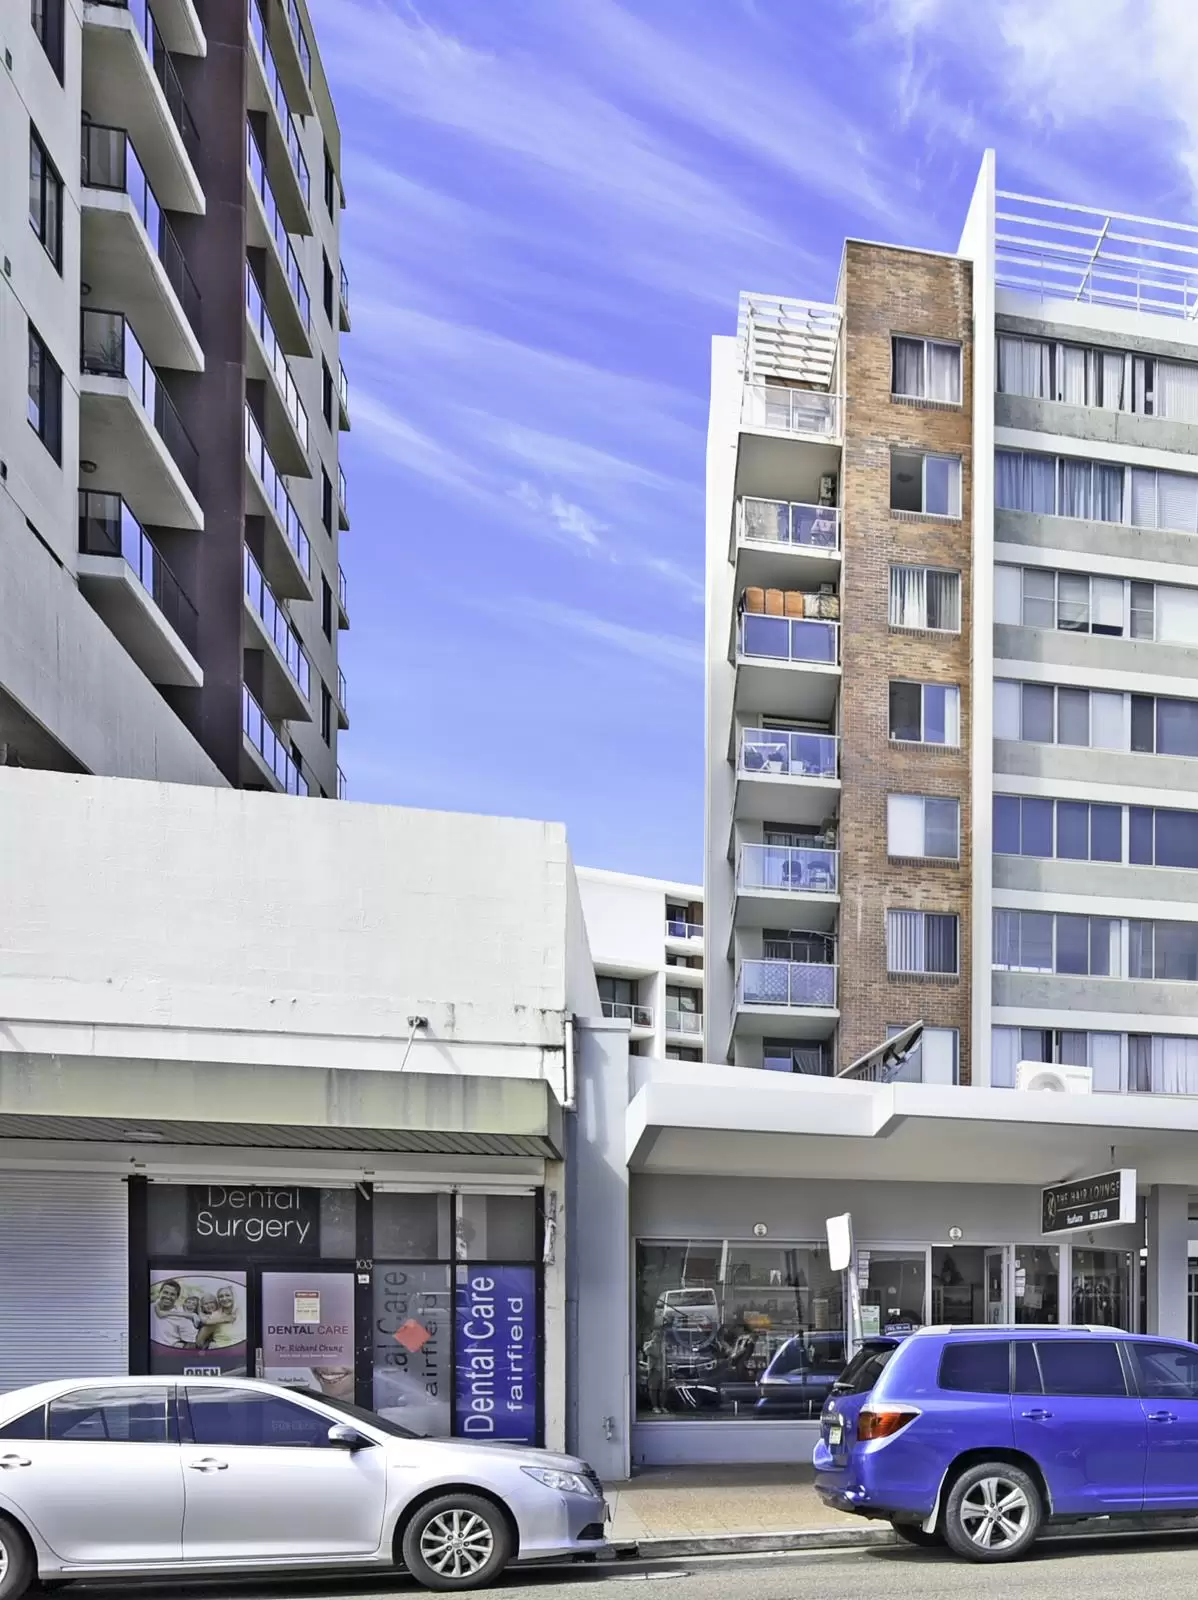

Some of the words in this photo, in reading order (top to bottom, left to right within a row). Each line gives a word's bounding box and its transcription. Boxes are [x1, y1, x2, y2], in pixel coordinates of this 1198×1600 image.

[208, 1186, 300, 1210] Dental
[197, 1211, 310, 1243] Surgery
[356, 1260, 372, 1269] 103
[464, 1276, 494, 1340] Care
[267, 1325, 315, 1335] DENTAL
[317, 1325, 349, 1335] CARE
[507, 1297, 524, 1411] fairfield
[464, 1348, 494, 1433] Dental
